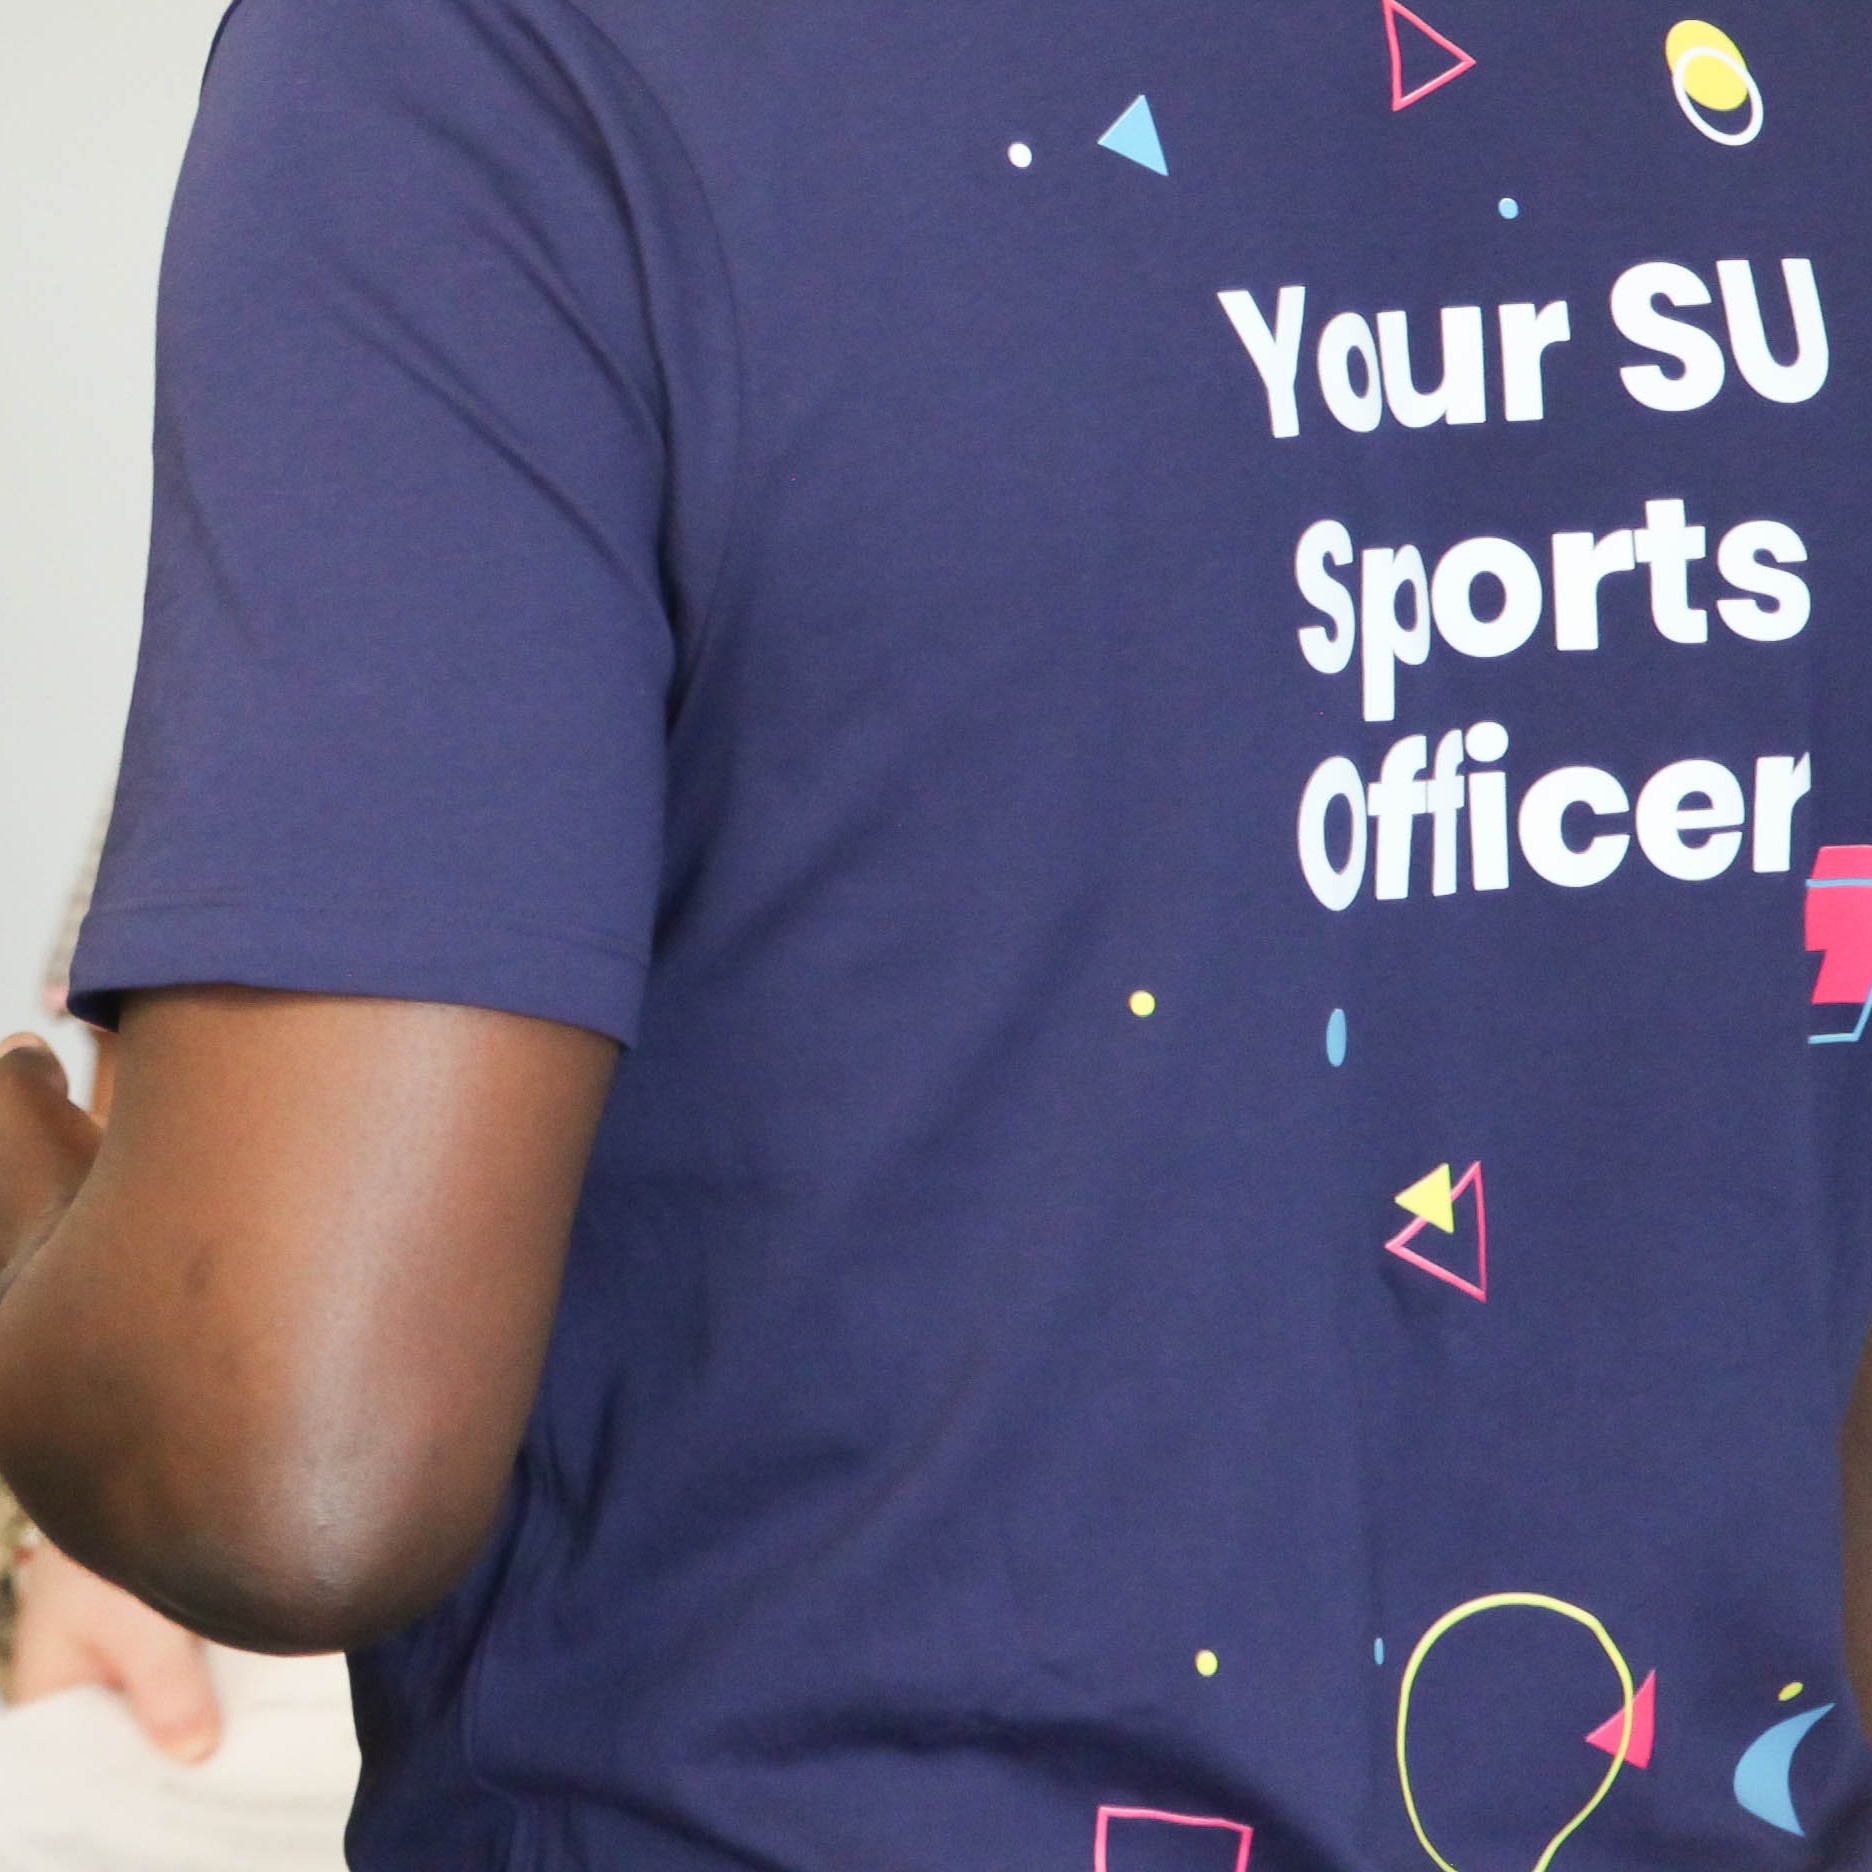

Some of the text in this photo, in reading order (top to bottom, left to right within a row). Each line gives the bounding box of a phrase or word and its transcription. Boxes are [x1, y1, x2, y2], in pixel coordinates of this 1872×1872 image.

[1216, 257, 1829, 439] Your SU
[1294, 498, 1812, 722] Sports
[1296, 720, 1812, 912] Officer
